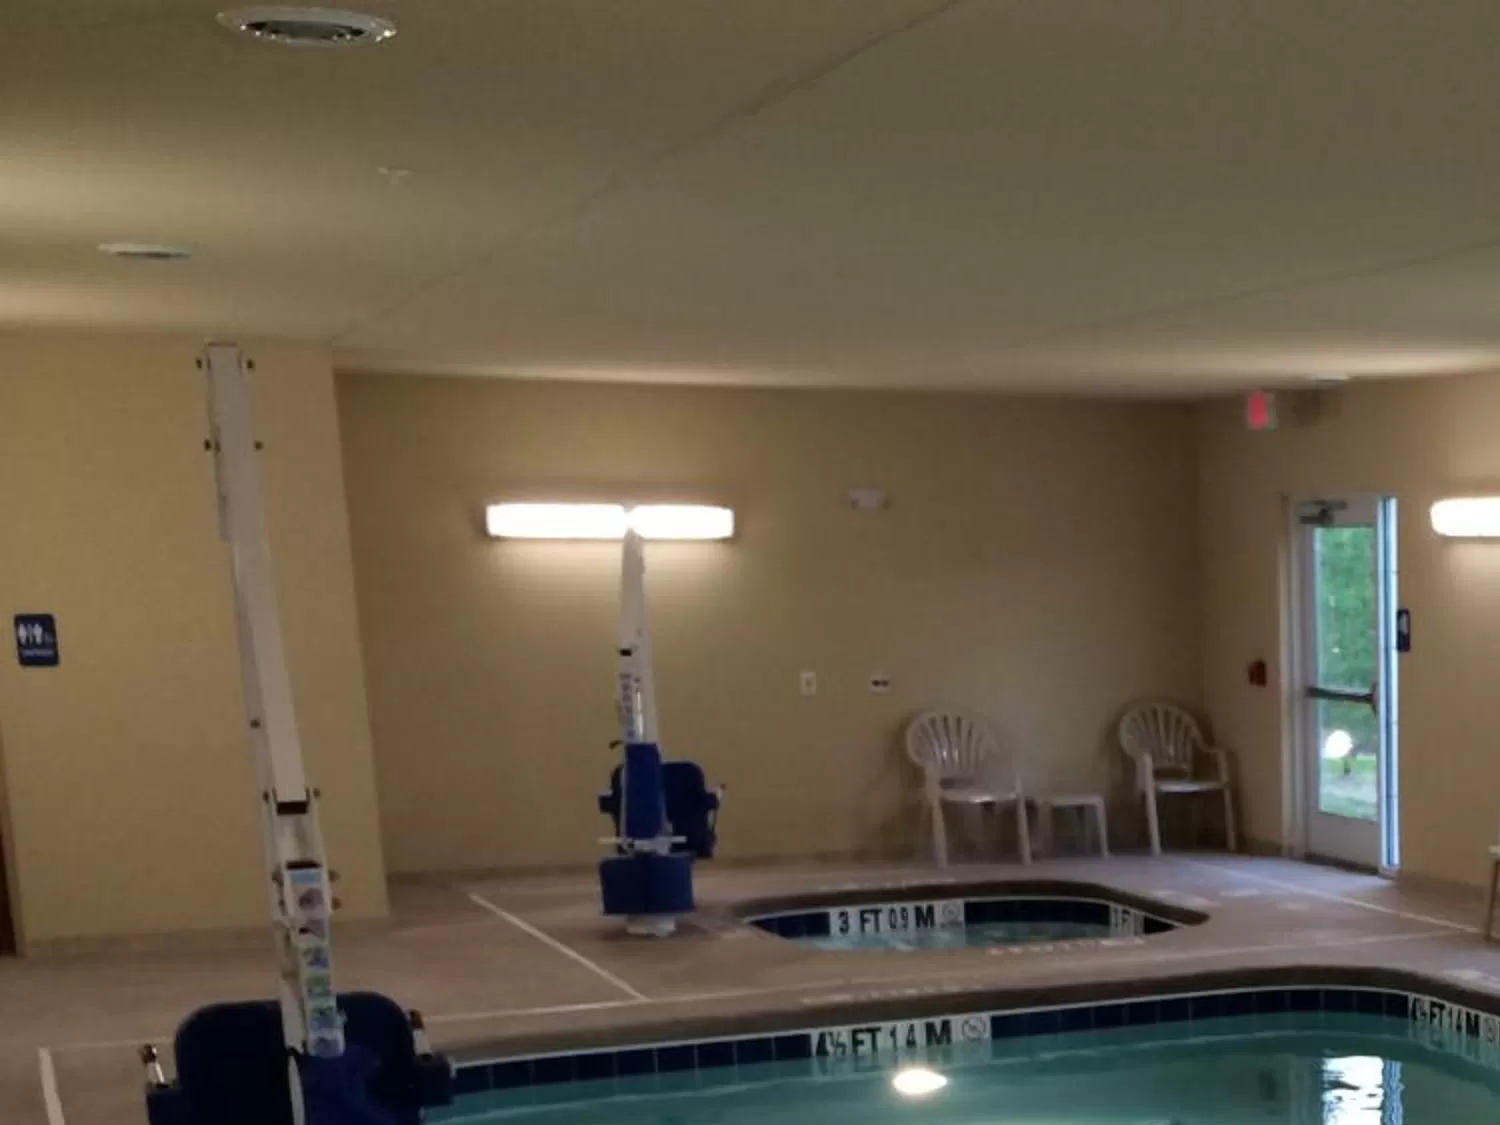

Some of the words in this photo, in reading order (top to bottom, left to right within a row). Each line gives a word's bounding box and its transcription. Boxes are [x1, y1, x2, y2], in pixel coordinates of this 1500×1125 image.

[839, 908, 850, 935] 3
[860, 907, 883, 933] FT
[915, 903, 936, 929] M
[851, 1026, 882, 1055] FT
[925, 1019, 952, 1046] M
